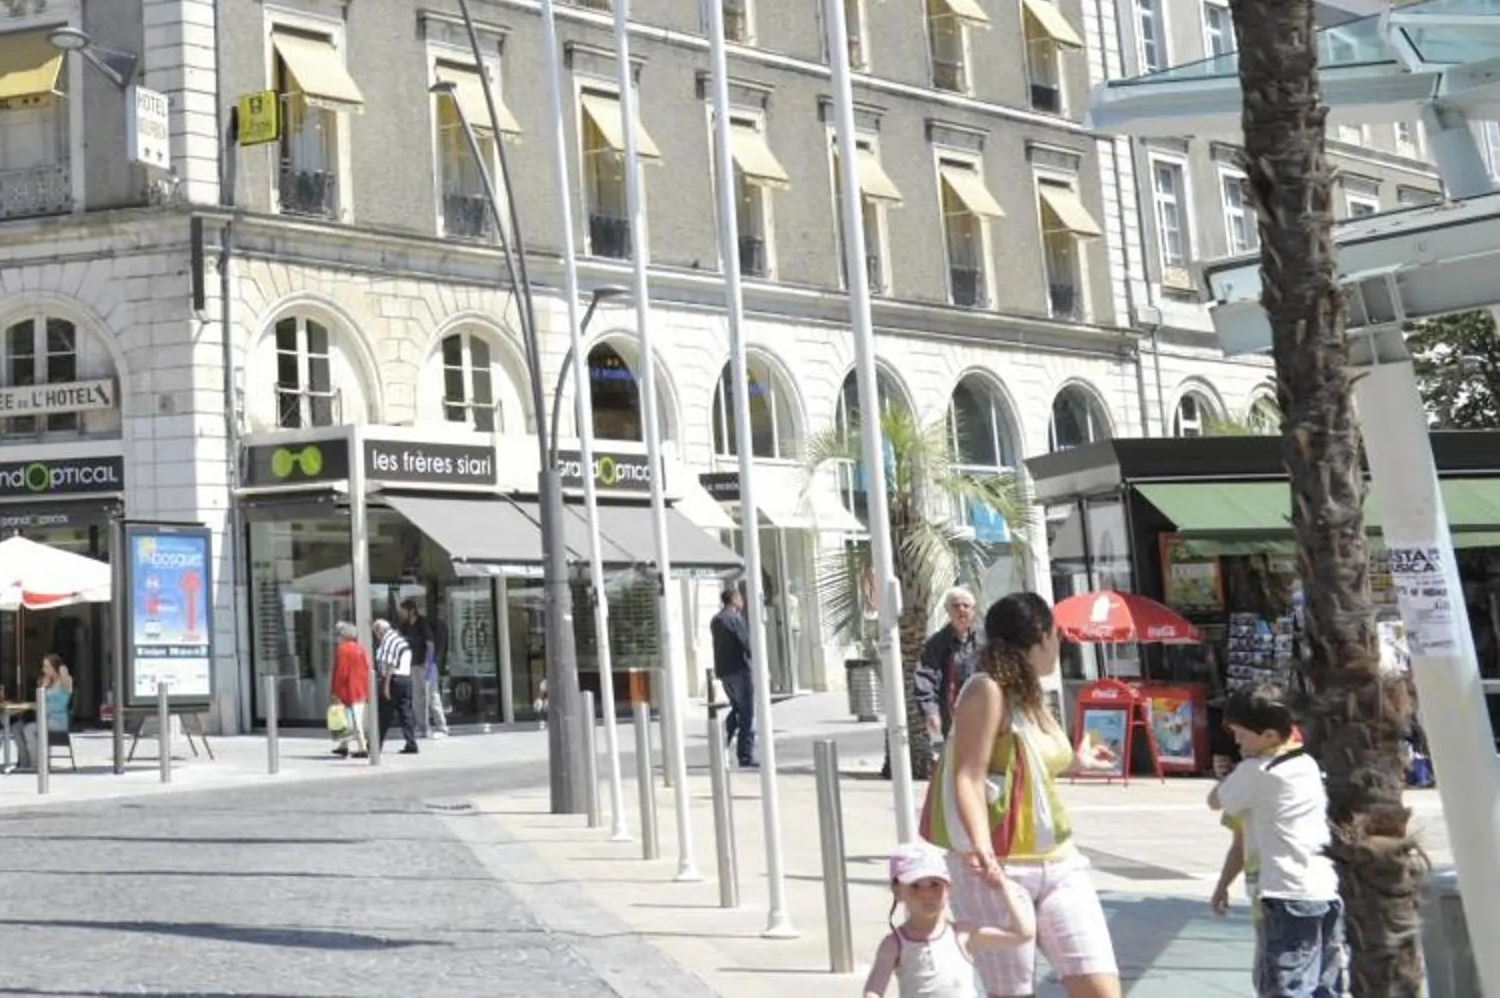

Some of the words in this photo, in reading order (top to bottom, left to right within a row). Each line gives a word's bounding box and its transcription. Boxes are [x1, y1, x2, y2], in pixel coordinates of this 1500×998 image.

[372, 450, 399, 471] les
[404, 451, 453, 474] frères
[457, 455, 491, 476] siari
